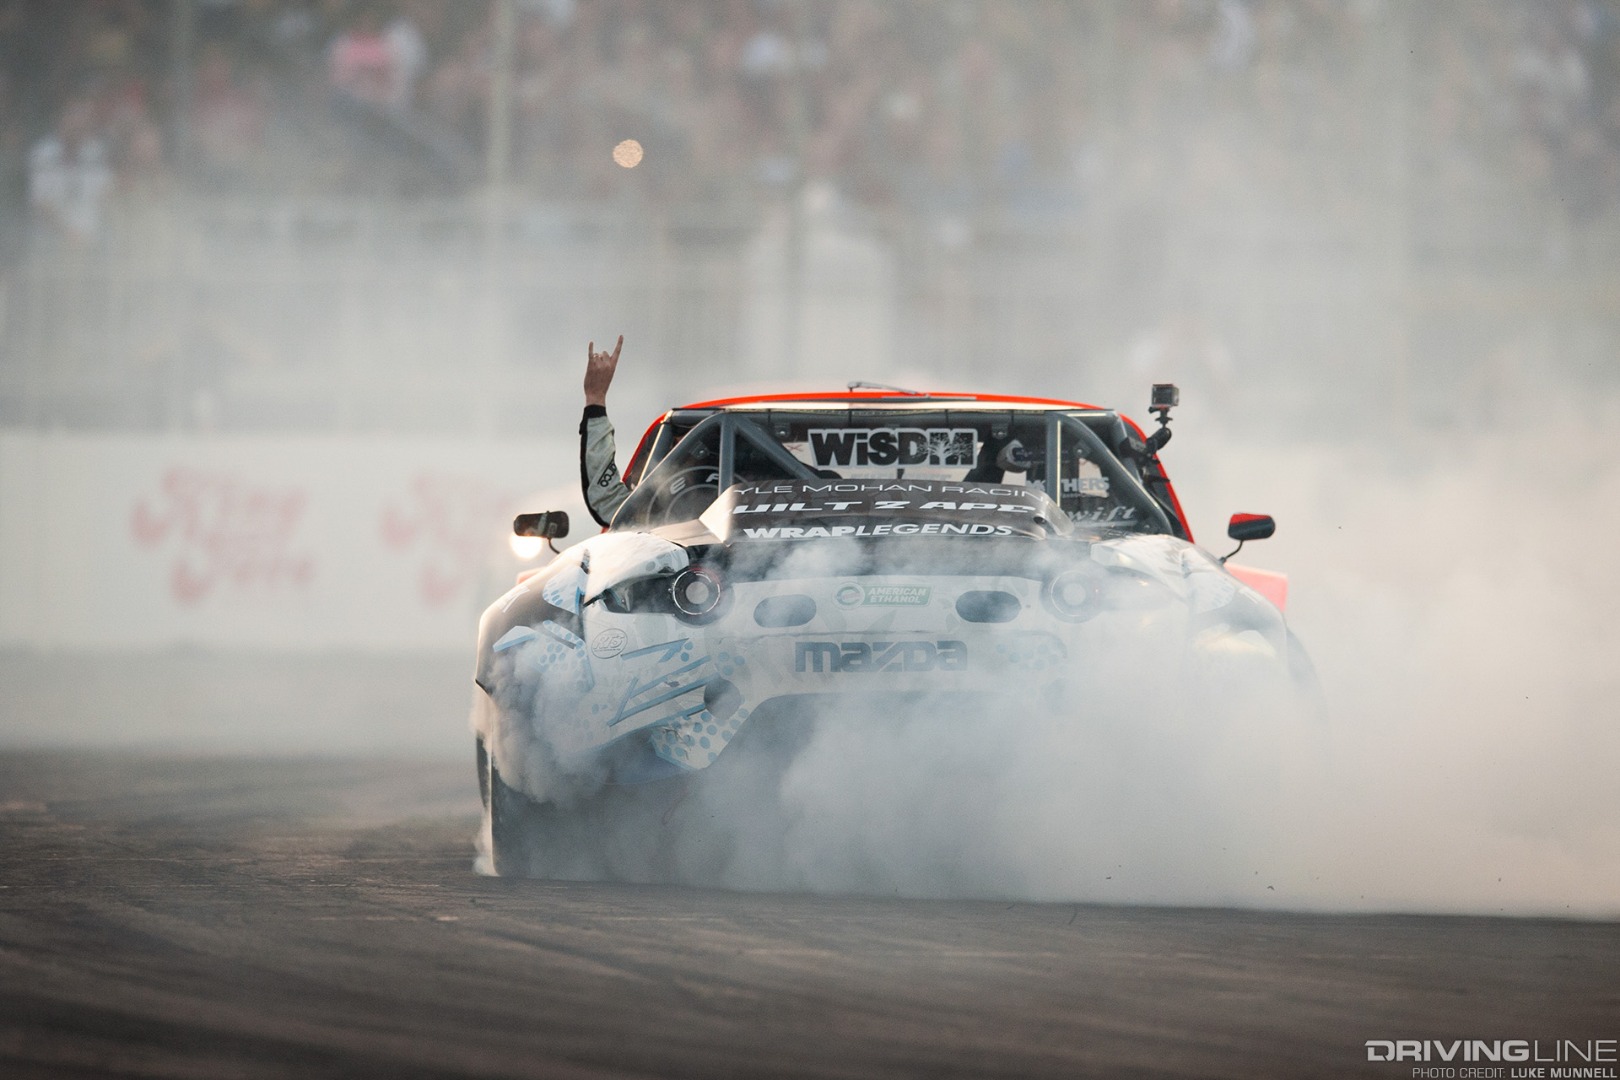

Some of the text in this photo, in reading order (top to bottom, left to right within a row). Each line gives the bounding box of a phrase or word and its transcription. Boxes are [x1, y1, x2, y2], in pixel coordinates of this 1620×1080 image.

[733, 484, 1044, 502] YLE MOHAN RACIN
[733, 501, 862, 514] UILT
[919, 501, 1036, 513] APE
[1067, 505, 1137, 522] wift
[868, 587, 927, 596] AMERICAN
[870, 595, 921, 603] ETHANOL
[795, 640, 967, 672] mazda
